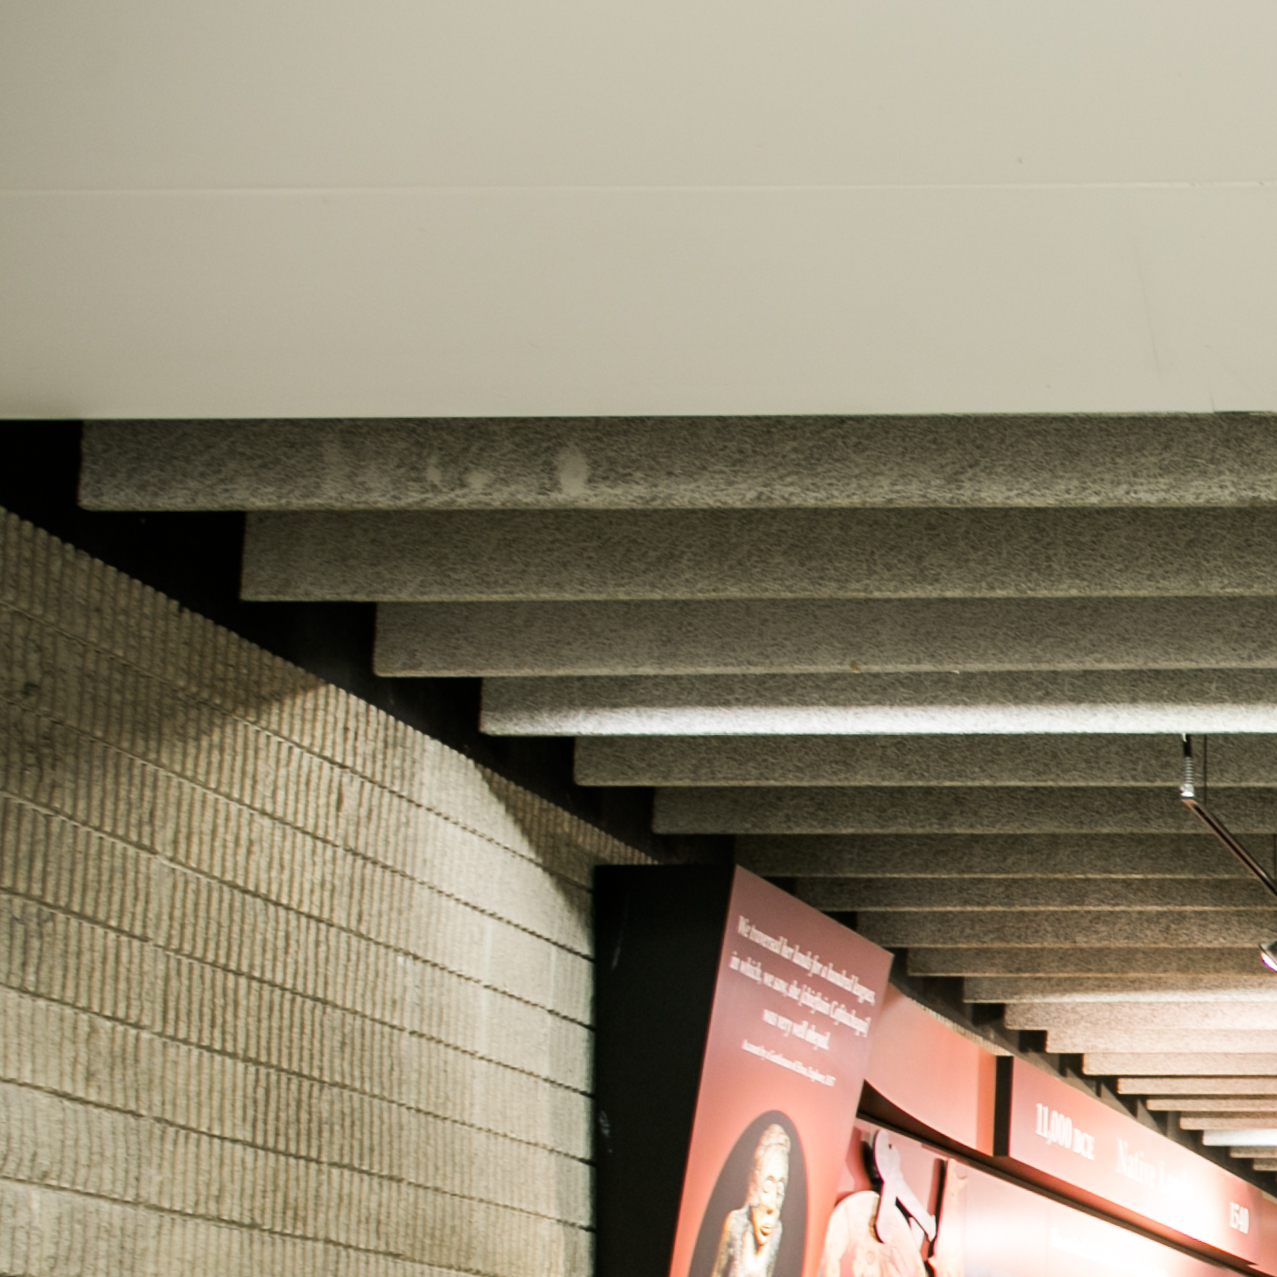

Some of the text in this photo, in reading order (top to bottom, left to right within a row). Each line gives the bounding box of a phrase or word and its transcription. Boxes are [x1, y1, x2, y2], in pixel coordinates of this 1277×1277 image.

[1034, 1102, 1072, 1150] 11,000
[1072, 1127, 1095, 1160] BCE
[1115, 1137, 1156, 1189] Native
[1228, 1201, 1250, 1235] 1540
